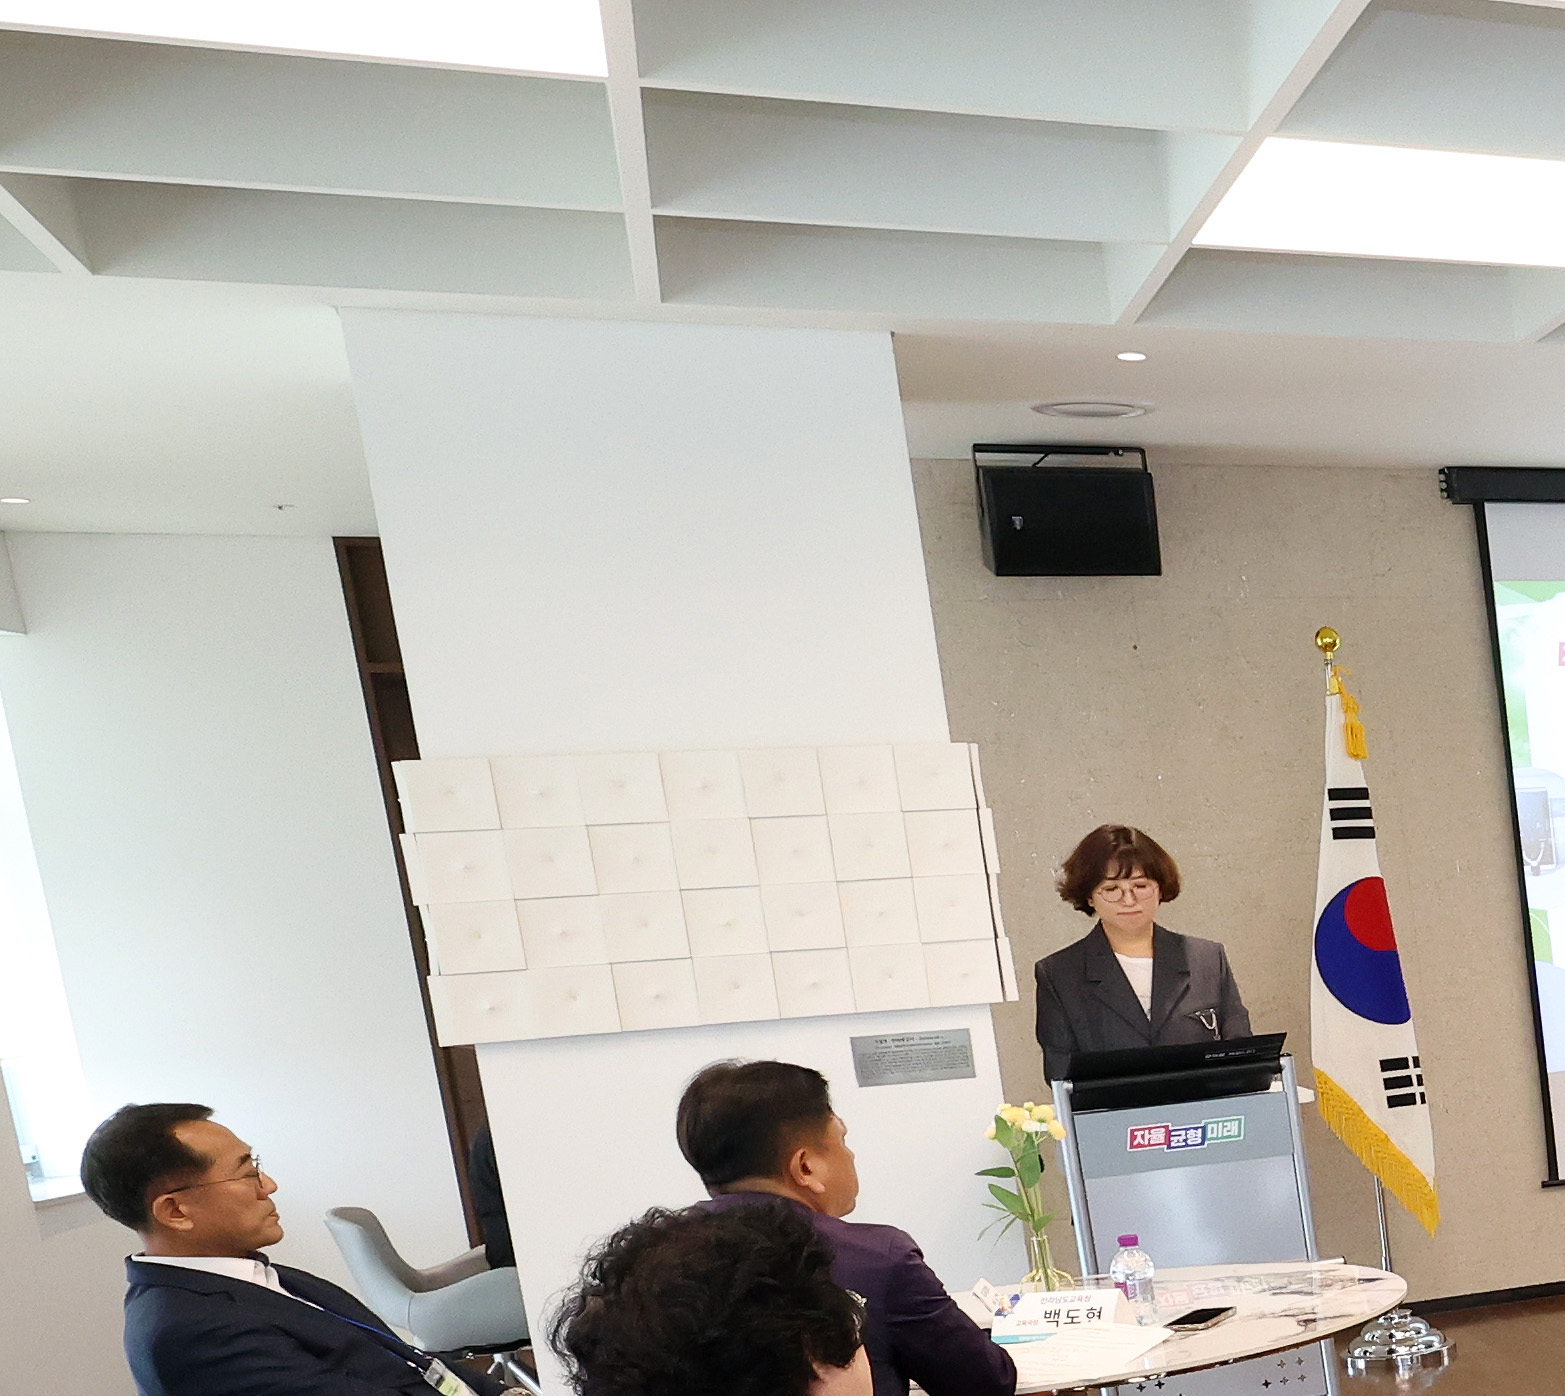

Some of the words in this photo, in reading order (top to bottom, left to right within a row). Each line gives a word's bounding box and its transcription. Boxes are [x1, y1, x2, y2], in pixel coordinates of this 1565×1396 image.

[1132, 1127, 1166, 1146] 자율
[1170, 1128, 1202, 1147] 균형
[1207, 1120, 1239, 1138] 미래
[1040, 1294, 1092, 1305] 전라남도교육청
